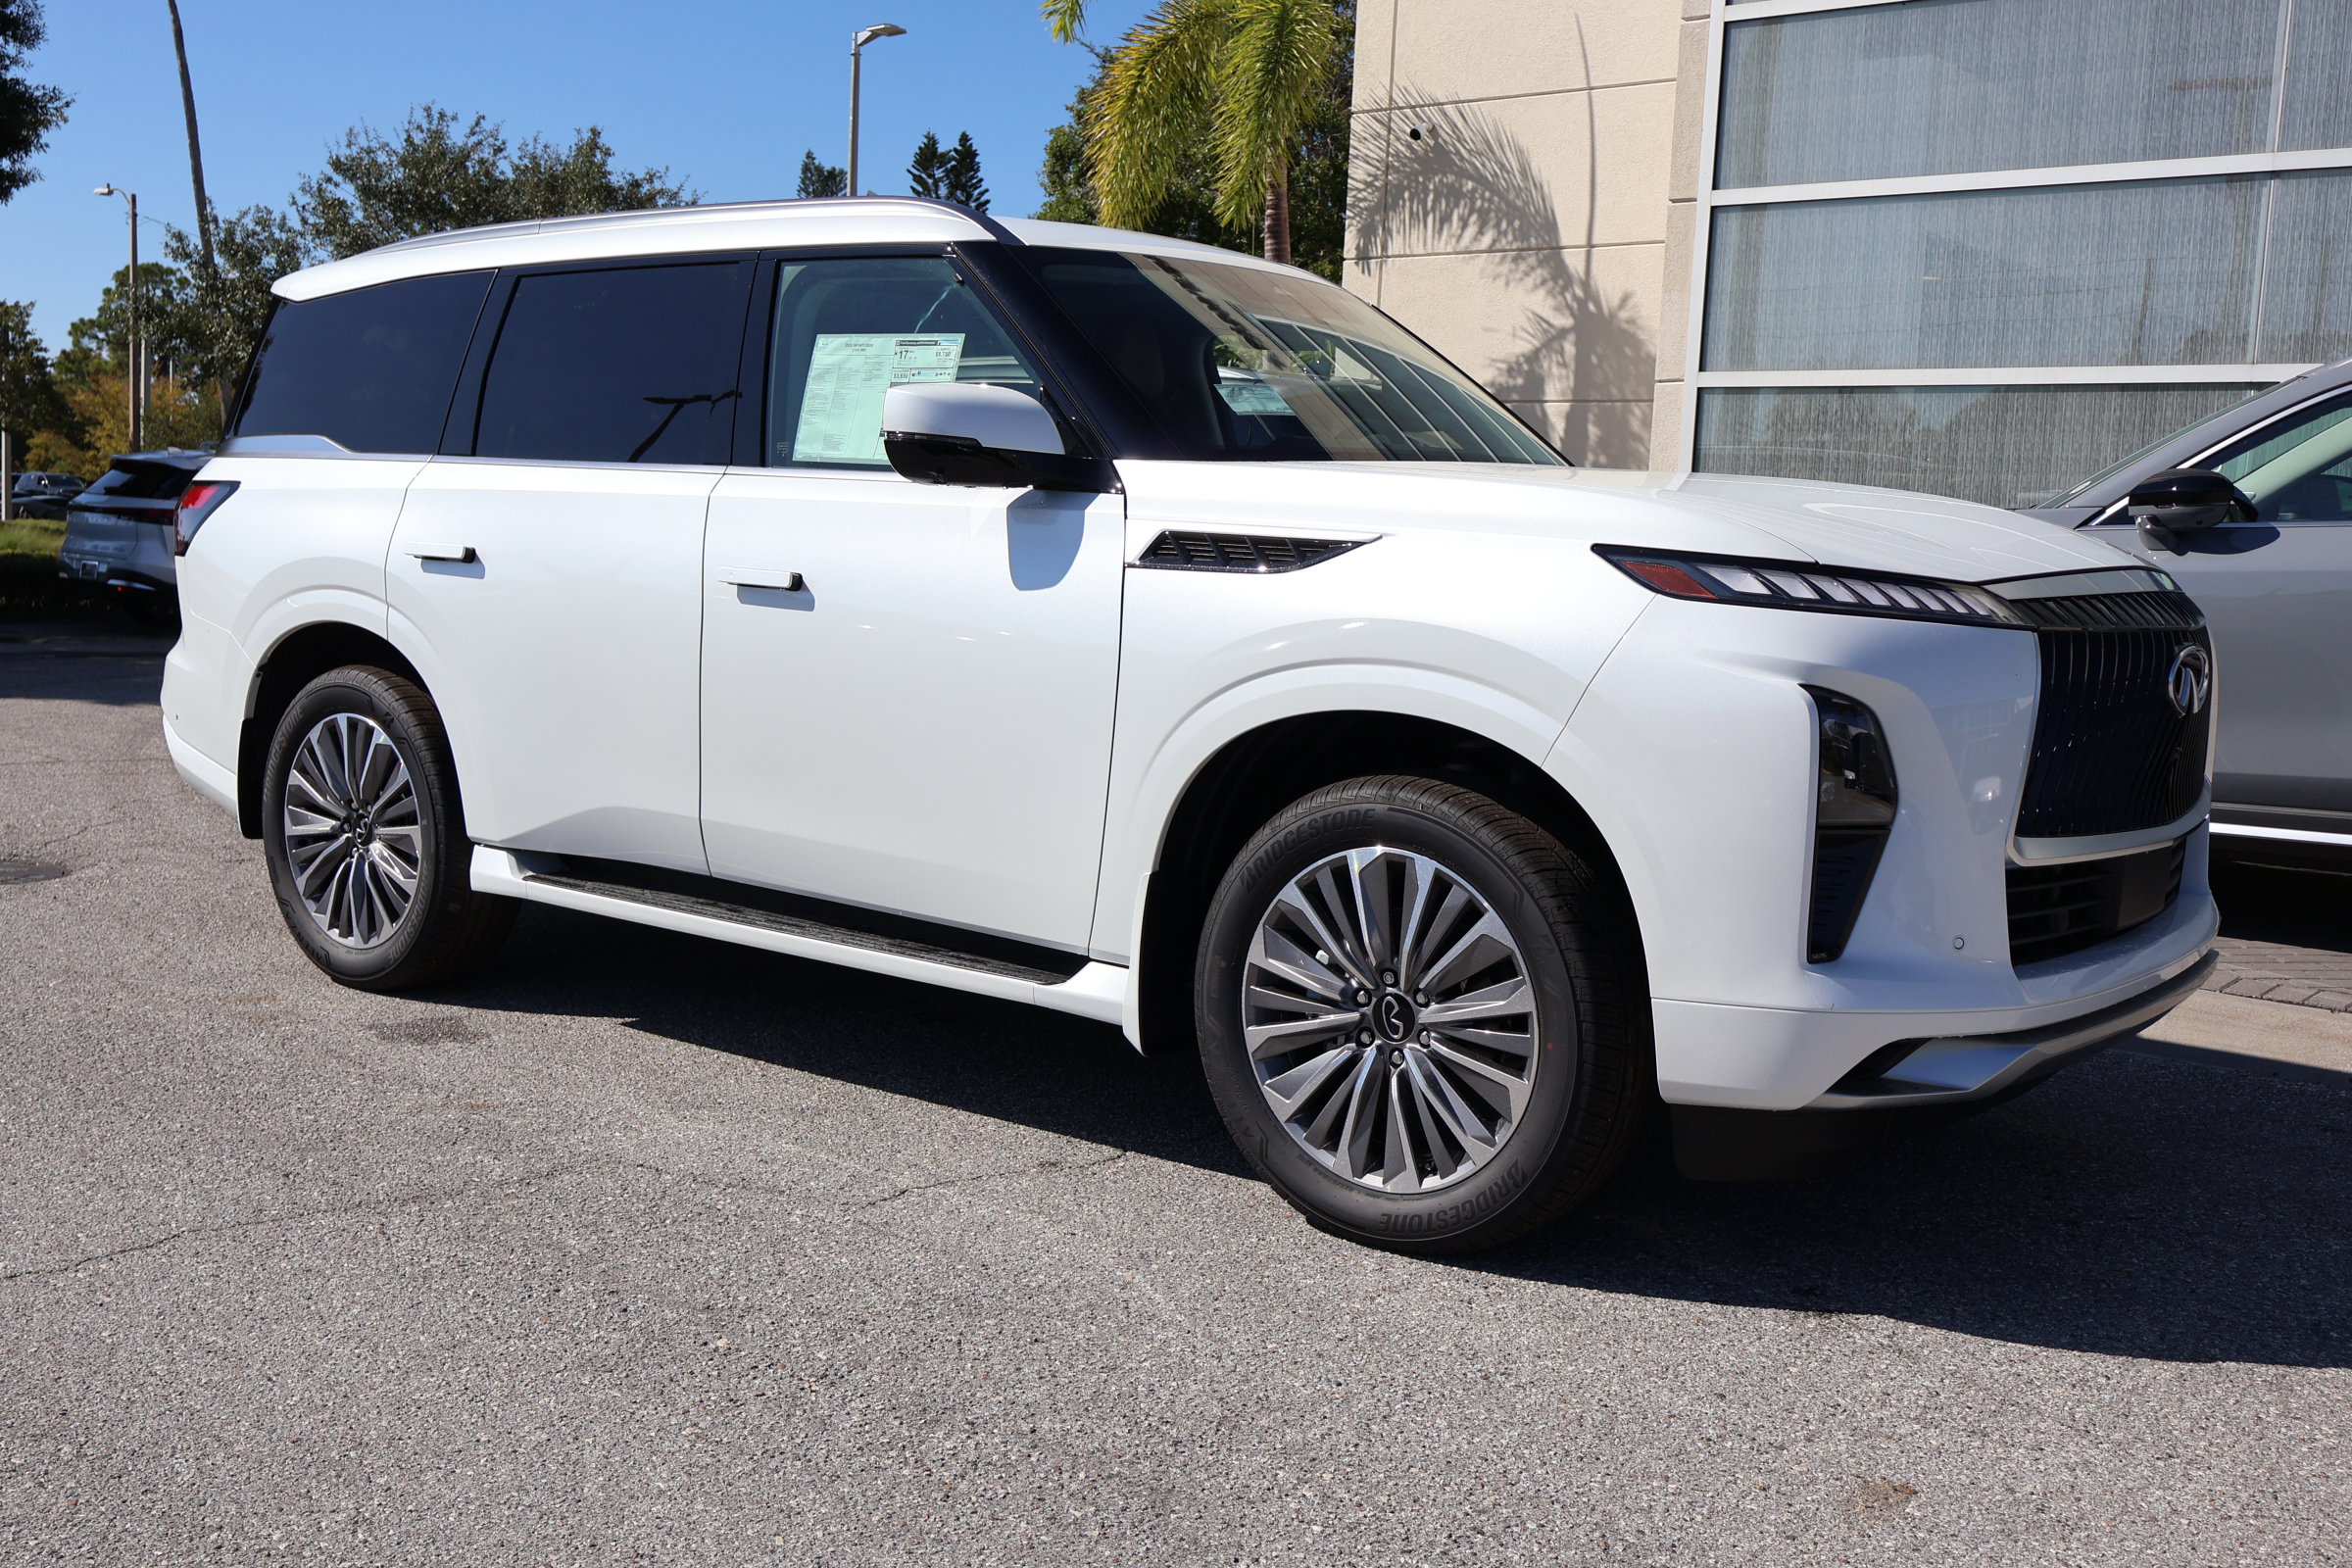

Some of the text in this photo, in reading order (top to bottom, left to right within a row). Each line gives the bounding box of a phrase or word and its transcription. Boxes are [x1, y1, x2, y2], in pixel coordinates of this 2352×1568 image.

[899, 350, 909, 360] 17
[1239, 808, 1377, 895] BRIDGESTONE
[1380, 1159, 1529, 1233] BRIDGESTONE
